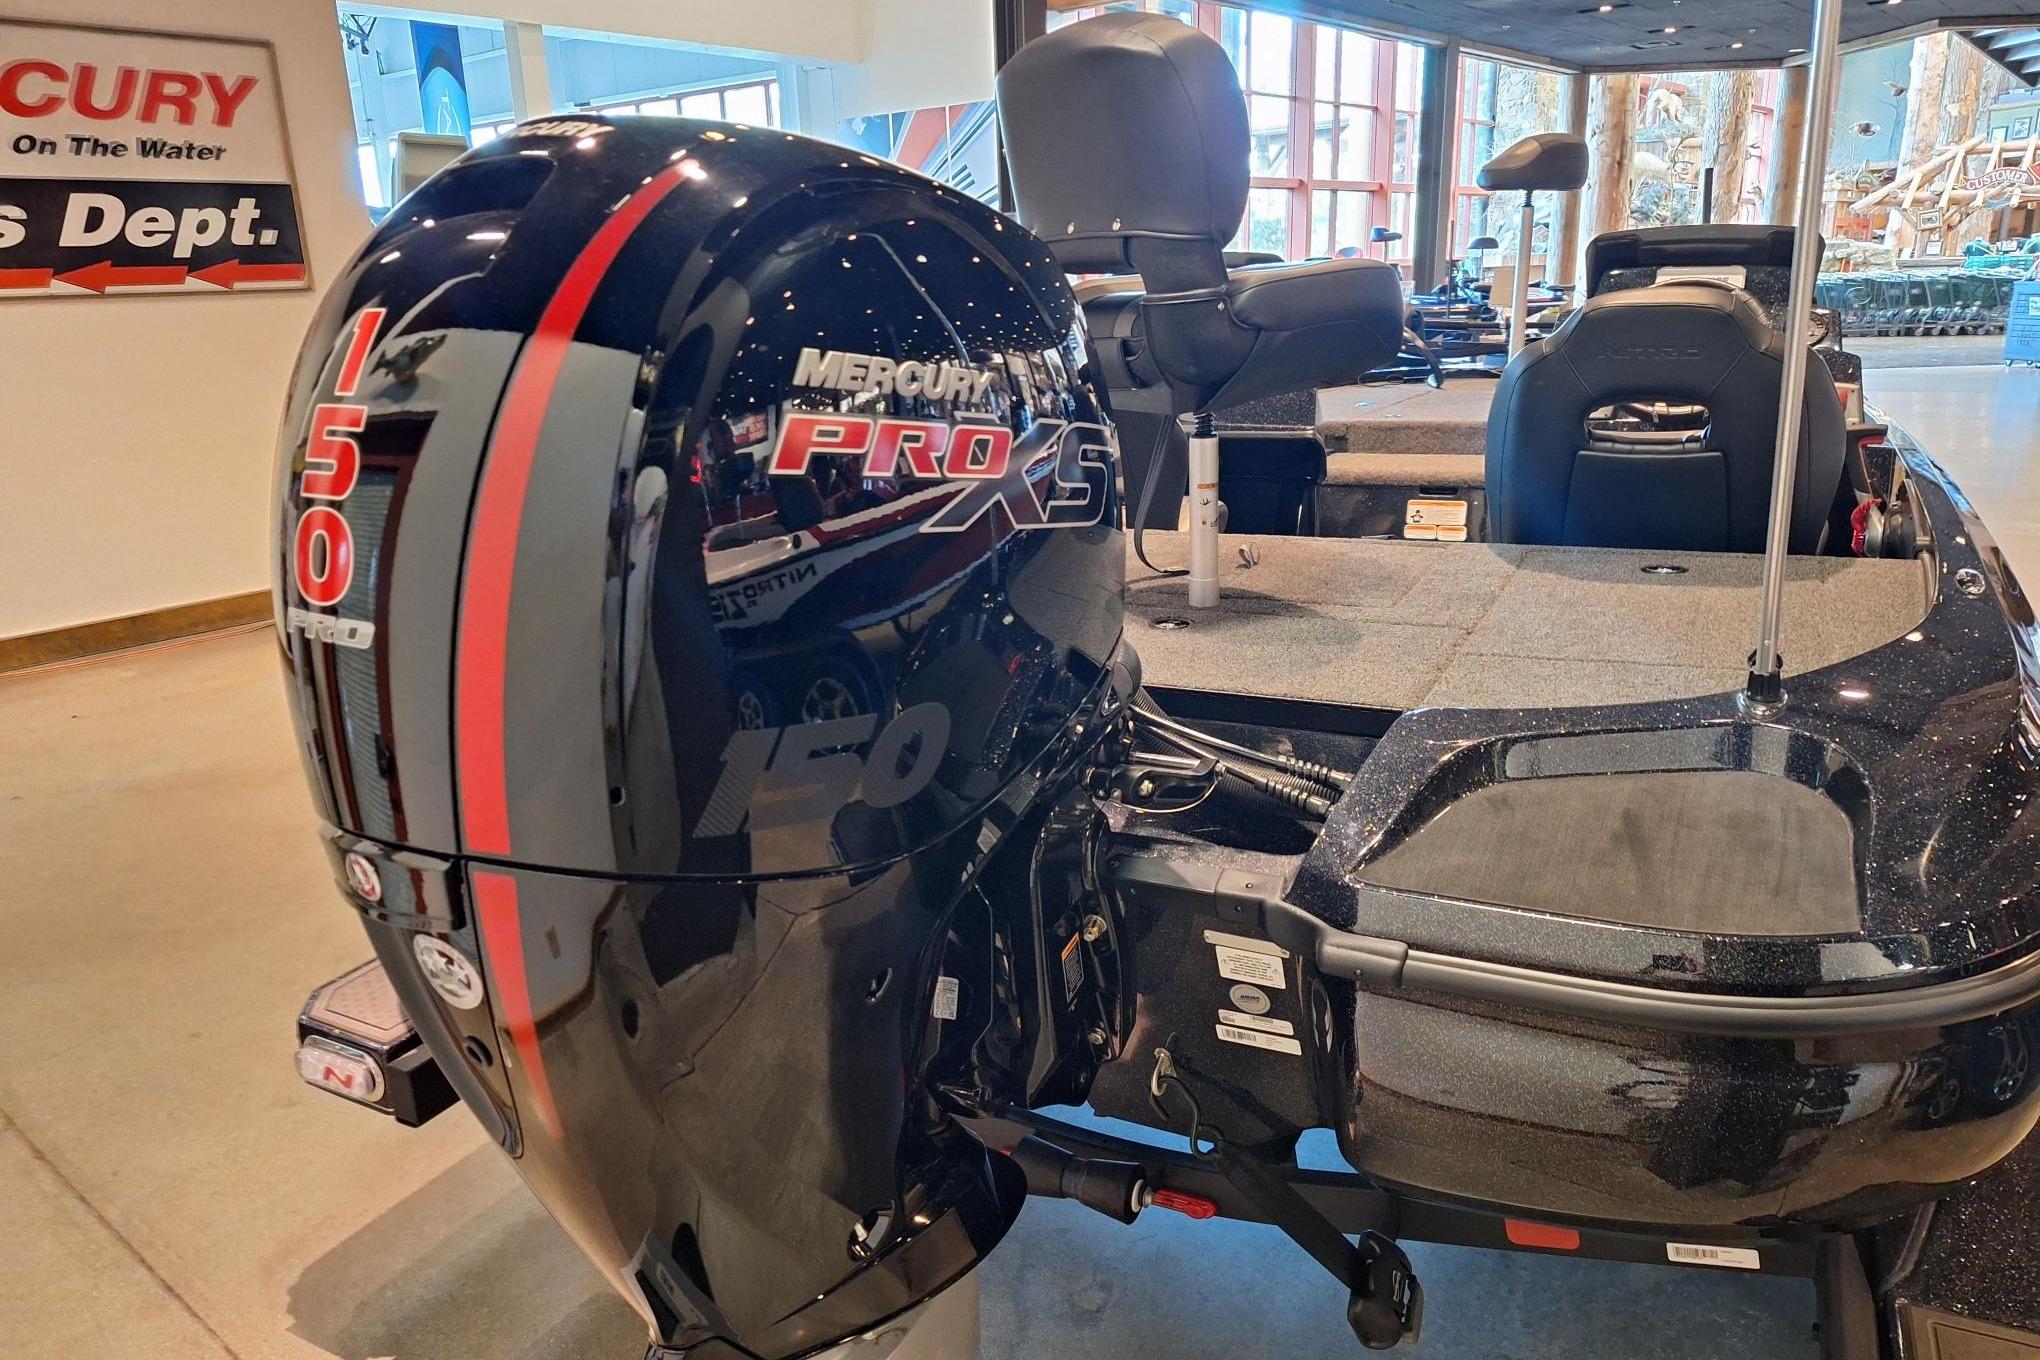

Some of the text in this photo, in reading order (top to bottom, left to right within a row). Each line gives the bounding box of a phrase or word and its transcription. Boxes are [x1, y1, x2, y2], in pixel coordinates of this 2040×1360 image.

[11, 133, 227, 161] On The Water
[1966, 169, 2028, 190] CUSTOMER
[58, 192, 279, 258] Dept.
[793, 347, 993, 402] MERCURY
[768, 412, 1013, 479] PRO
[287, 607, 376, 650] PRO
[691, 702, 950, 840] 150
